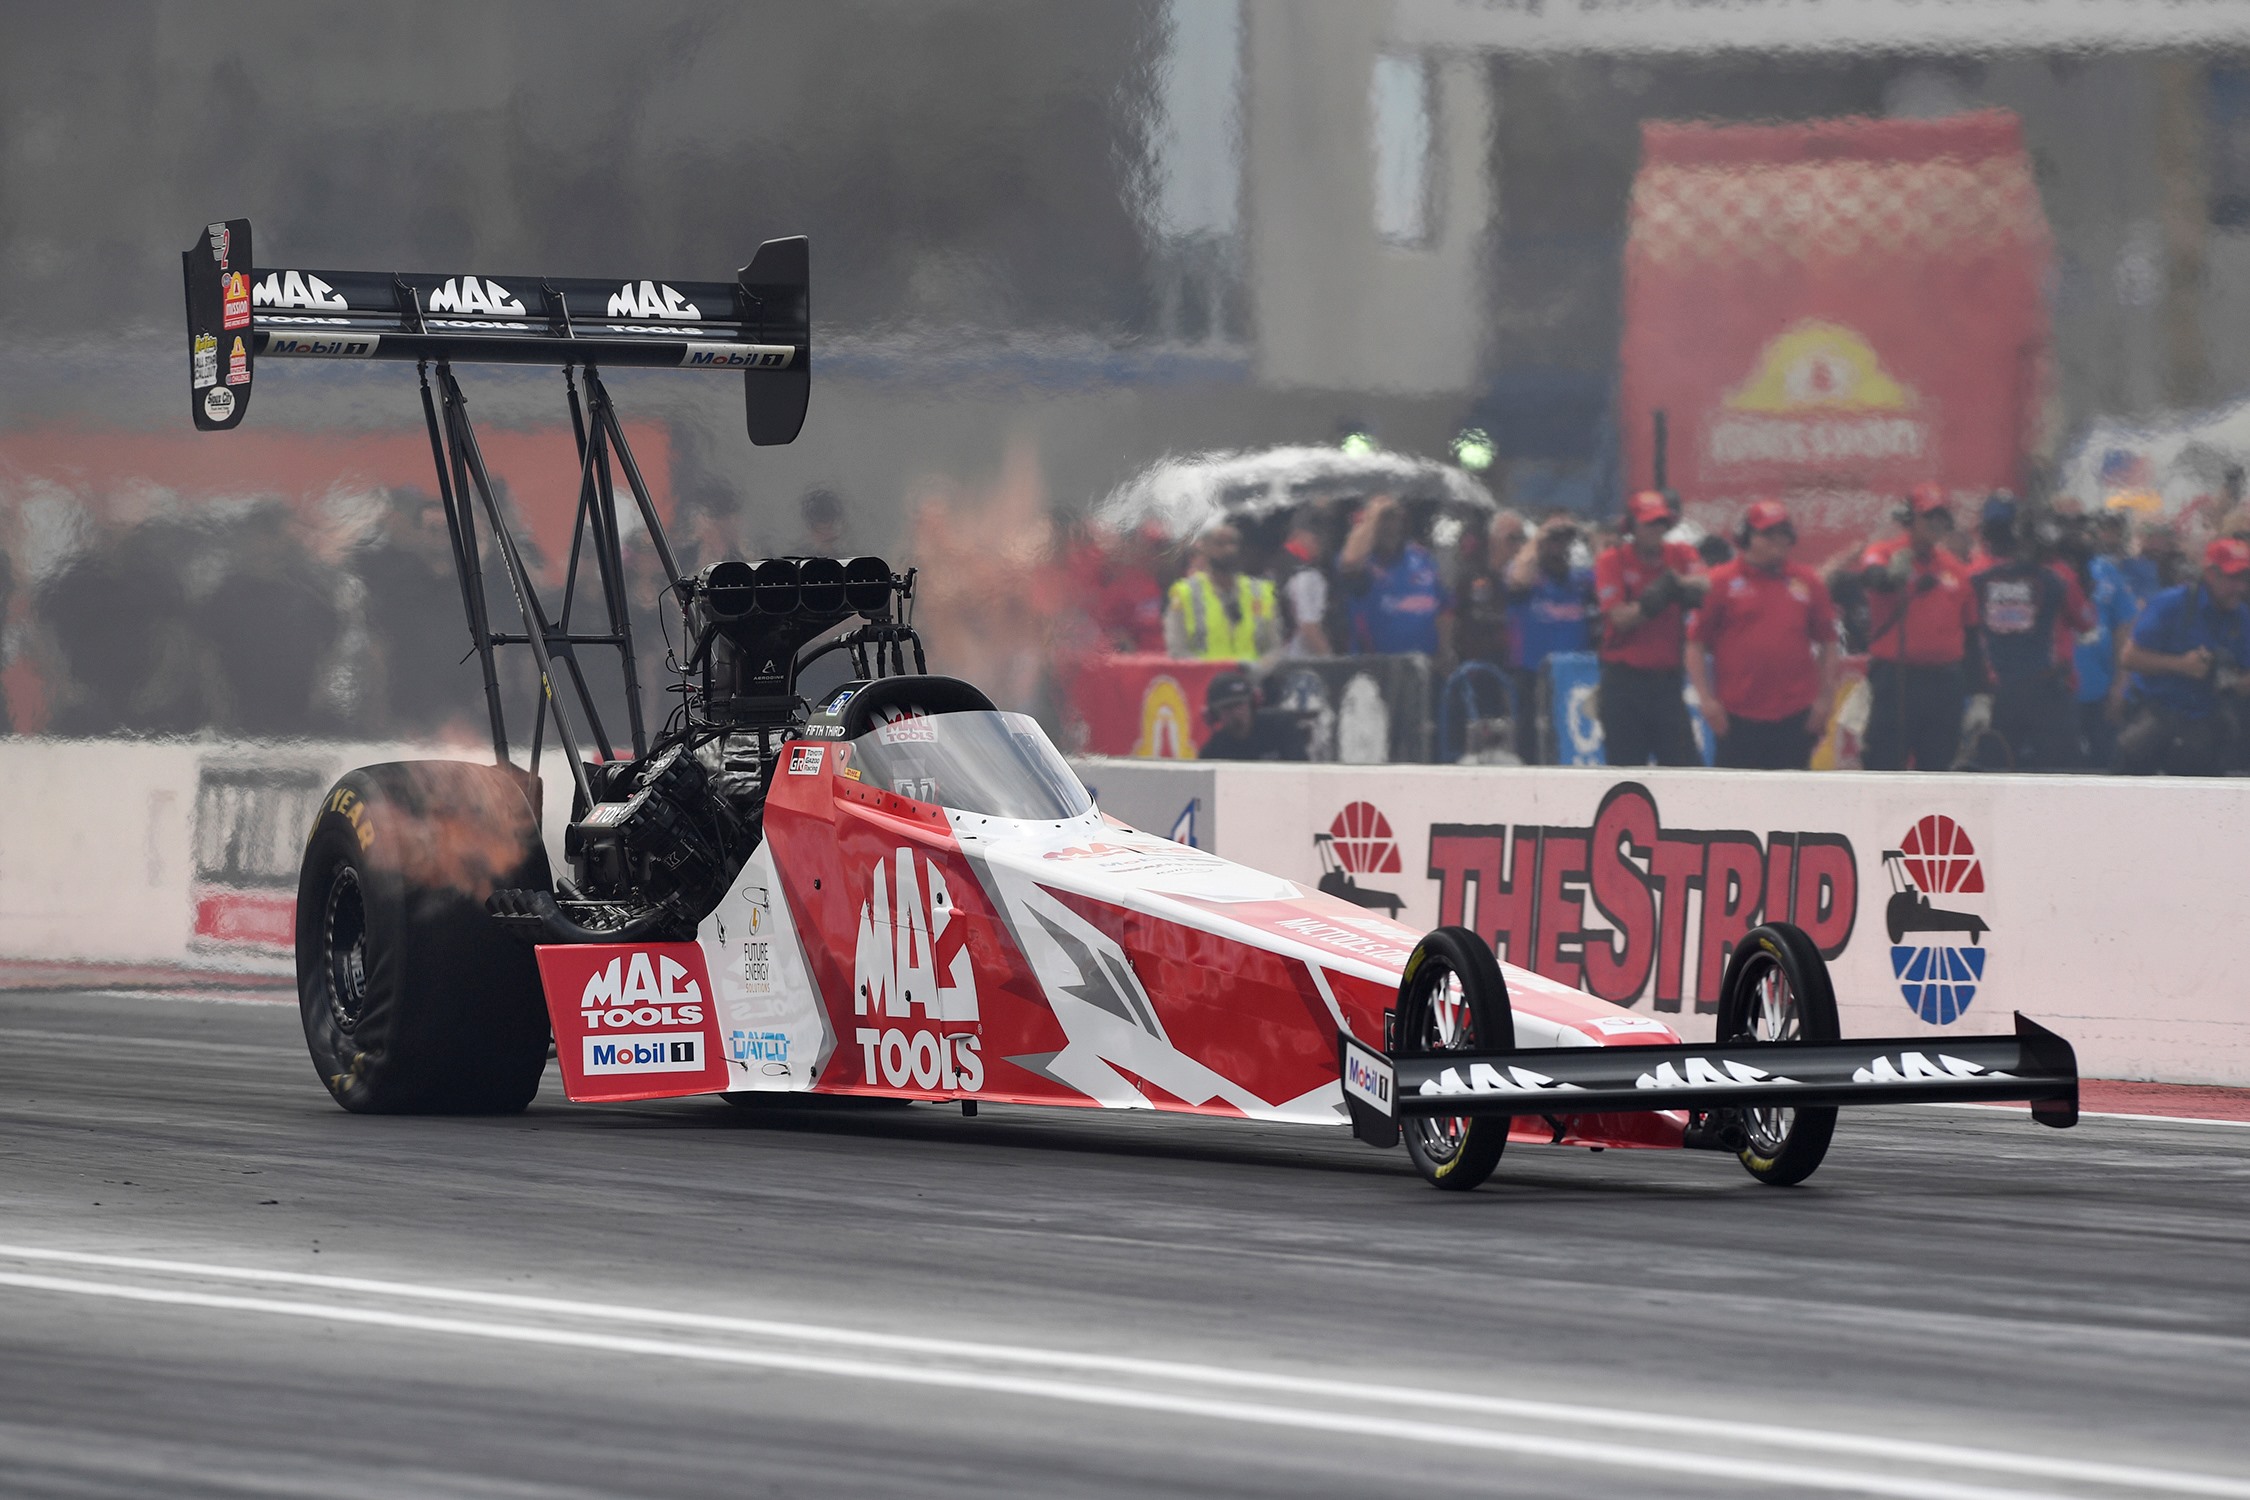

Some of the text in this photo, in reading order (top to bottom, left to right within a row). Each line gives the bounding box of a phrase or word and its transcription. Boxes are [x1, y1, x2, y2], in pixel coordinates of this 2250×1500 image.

[252, 270, 348, 310] MAC
[429, 276, 527, 316] MAC
[607, 280, 702, 320] MAC
[253, 315, 351, 324] TOOLS
[428, 319, 529, 330] TOOLS
[606, 325, 704, 335] TOOLS
[273, 340, 343, 355] Mobil
[690, 352, 759, 366] Mobil
[805, 724, 846, 737] FIFTH THIRD
[887, 731, 935, 742] TOOLS
[790, 757, 804, 771] GR
[855, 847, 980, 1021] MAC
[744, 942, 769, 961] FUTURE
[581, 952, 703, 1008] MAC
[745, 963, 770, 981] ENERGY
[745, 982, 771, 993] SOLUTIONS
[581, 1005, 704, 1029] TOOLS
[593, 1042, 665, 1066] Mobil
[731, 1030, 789, 1062] DAYCO
[856, 1028, 985, 1092] TOOLS
[1852, 1052, 2023, 1083] MAC
[1349, 1056, 1378, 1096] Mobil
[1419, 1063, 1588, 1095] MAC
[1635, 1057, 1803, 1089] MAC
